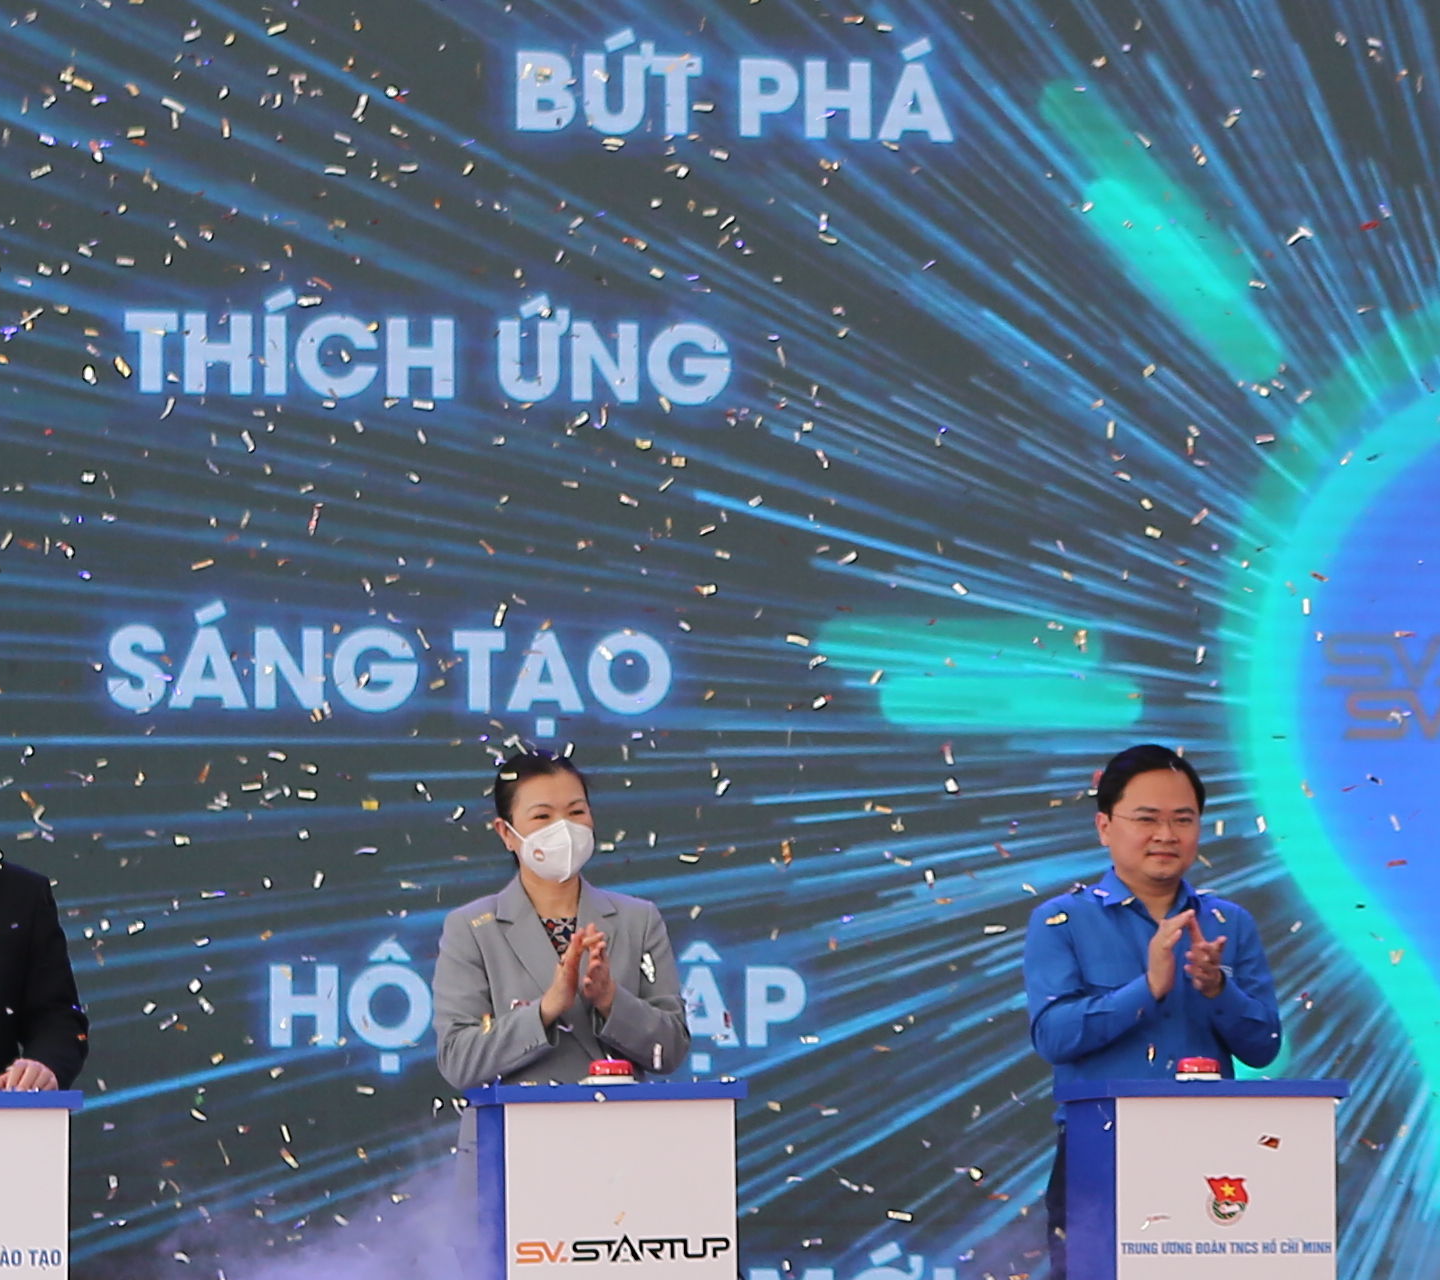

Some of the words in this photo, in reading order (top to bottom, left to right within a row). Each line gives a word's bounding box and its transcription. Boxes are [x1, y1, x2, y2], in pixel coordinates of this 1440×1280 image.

[515, 27, 702, 136] BỨT
[739, 37, 954, 143] PHÁ
[124, 289, 457, 400] THÍCH
[497, 294, 733, 406] ỨNG
[107, 599, 420, 713] SÁNG
[452, 630, 673, 738] TẠO
[269, 941, 433, 1074] HỘ
[679, 941, 807, 1072] ẬP
[28, 1248, 63, 1272] TẠO
[1121, 1242, 1158, 1255] TRUNG
[1229, 1242, 1259, 1255] TNCS
[1302, 1240, 1332, 1255] MINH
